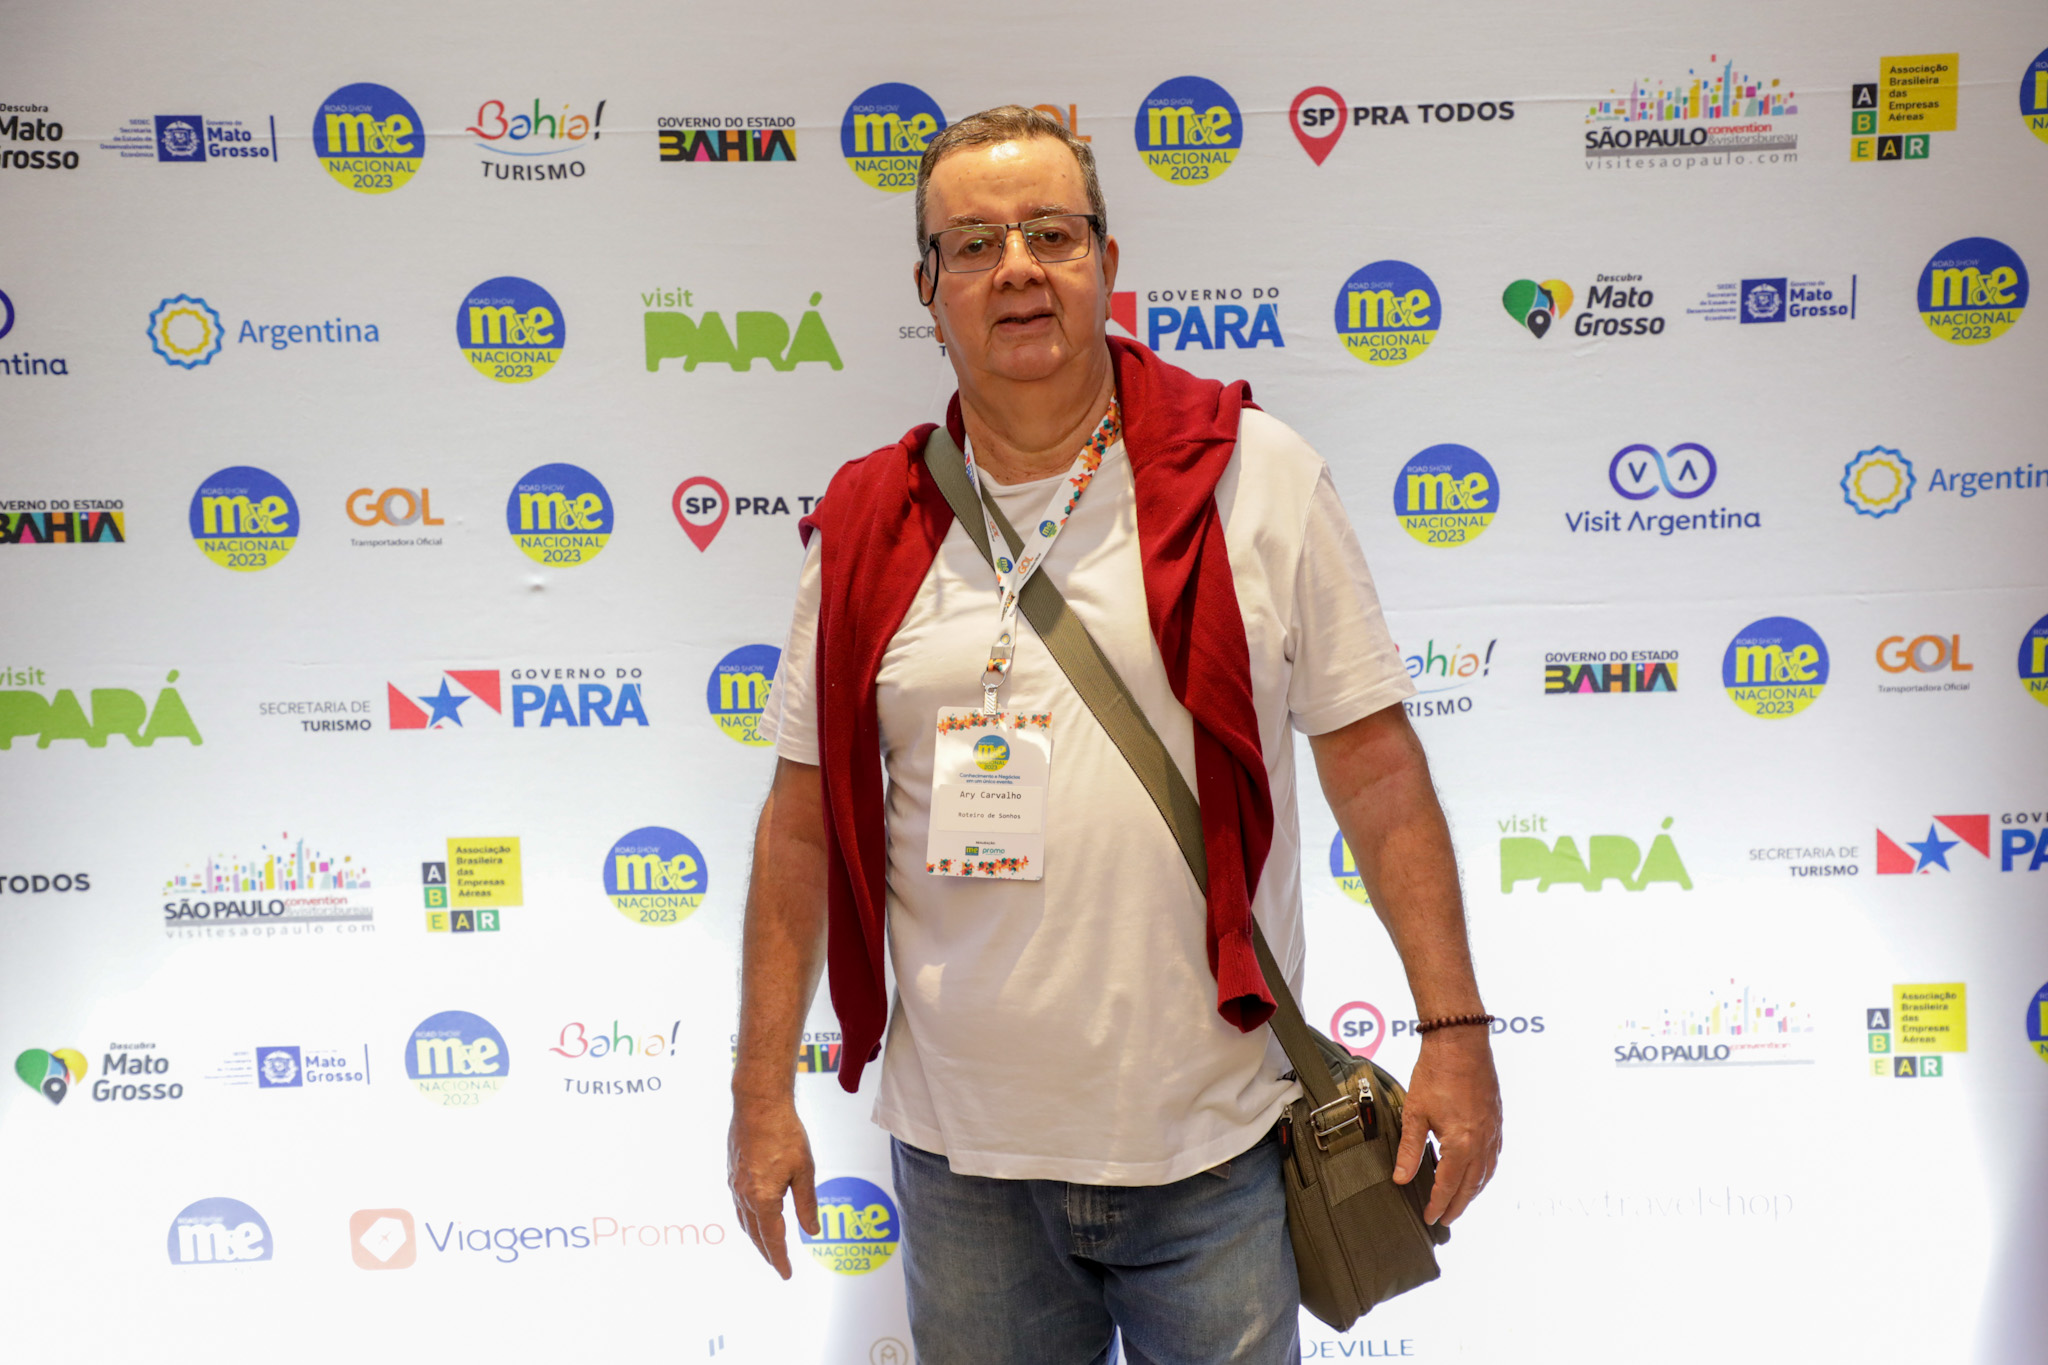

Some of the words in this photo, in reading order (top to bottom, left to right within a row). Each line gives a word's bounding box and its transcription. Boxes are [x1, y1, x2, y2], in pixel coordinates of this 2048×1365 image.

[1889, 64, 1948, 75] Associação
[1889, 78, 1939, 86] Brasileira
[1889, 90, 1907, 98] das
[0, 103, 48, 113] Descubra
[1148, 98, 1168, 106] ROAD
[1889, 103, 1939, 113] Empresas
[465, 98, 607, 141] Bahia!
[1302, 108, 1336, 126] SP
[1353, 105, 1410, 126] PRA
[1418, 101, 1515, 123] TODOS
[0, 115, 63, 142] Mato
[657, 117, 721, 128] GOVERNO
[725, 117, 743, 127] DO
[747, 117, 796, 127] ESTADO
[1708, 123, 1772, 134] convention
[207, 128, 251, 142] Mato
[1585, 126, 1632, 150] SÃO
[1635, 127, 1708, 149] PAULO
[1708, 133, 1798, 146] &visitorsbureau
[208, 143, 269, 157] Grosso
[658, 130, 797, 162] BAHIA
[1149, 152, 1231, 165] NACIONAL
[1585, 151, 1798, 169] visitesaopaulo.com
[329, 160, 416, 173] NACIONAL
[481, 161, 586, 181] TURISMO
[878, 172, 916, 187] 2023
[1171, 166, 1209, 181] 2023
[353, 174, 393, 188] 2023
[1597, 274, 1642, 283] Descubra
[641, 288, 693, 308] visit
[1148, 288, 1242, 302] GOVERNO
[1253, 287, 1279, 299] DO
[1587, 286, 1653, 309] Mato
[1790, 289, 1832, 303] Mato
[1790, 304, 1848, 317] Grosso
[1575, 313, 1664, 337] Grosso
[1930, 312, 2015, 326] NACIONAL
[238, 318, 380, 350] Argentina
[644, 291, 843, 372] PARÁ
[1952, 326, 1991, 340] 2023
[1348, 334, 1429, 347] NACIONAL
[472, 351, 555, 363] NACIONAL
[1369, 348, 1407, 361] 2023
[494, 365, 533, 378] 2023
[1928, 464, 2048, 498] Argentin
[51, 500, 69, 510] DO
[73, 500, 123, 510] ESTADO
[346, 488, 445, 526] GOL
[685, 498, 718, 514] SP
[736, 497, 790, 515] PRA
[1407, 516, 1488, 529] NACIONAL
[1565, 511, 1622, 532] Visit
[1628, 507, 1762, 536] Argentina
[351, 538, 414, 548] Transportadora
[416, 538, 443, 546] Oficial
[521, 536, 604, 548] NACIONAL
[1428, 530, 1466, 543] 2023
[204, 541, 289, 552] NACIONAL
[228, 554, 267, 567] 2023
[543, 550, 582, 563] 2023
[1545, 652, 1606, 662] GOVERNO
[1610, 652, 1628, 661] DO
[1632, 651, 1678, 661] ESTADO
[1876, 634, 1973, 674] GOL
[511, 668, 605, 680] GOVERNO
[616, 668, 643, 679] DO
[1545, 663, 1678, 694] BAHIA
[1735, 688, 1816, 701] NACIONAL
[1878, 685, 1941, 694] Transportadora
[1944, 682, 1970, 691] Oficial
[260, 702, 347, 715] SECRETARIA
[352, 701, 371, 713] DE
[1756, 701, 1794, 715] 2023
[302, 719, 372, 732] TURISMO
[960, 790, 976, 801] Ary
[980, 791, 1022, 800] Carvalho
[1498, 815, 1548, 833] visit
[456, 844, 511, 855] Associação
[1500, 817, 1693, 894] PARÁ
[1749, 848, 1835, 861] SECRETARIA
[1839, 847, 1859, 858] DE
[456, 856, 503, 864] Brasileira
[457, 867, 474, 875] das
[1789, 866, 1859, 876] TURISMO
[458, 879, 505, 888] Empresas
[458, 888, 492, 897] Aéreas
[284, 896, 347, 906] convention
[618, 897, 698, 907] NACIONAL
[164, 899, 210, 920] SÃO
[214, 899, 284, 918] PAULO
[640, 909, 677, 922] 2023
[1902, 992, 1957, 1000] Associação
[1902, 1003, 1949, 1012] Brasileira
[1902, 1014, 1919, 1022] das
[1342, 1021, 1374, 1037] SP
[1902, 1025, 1950, 1034] Empresas
[549, 1020, 681, 1058] Bahia!
[1903, 1035, 1936, 1043] Aéreas
[110, 1042, 156, 1050] Descubra
[1614, 1043, 1657, 1062] SÃO
[1661, 1045, 1730, 1061] PAULO
[103, 1053, 169, 1075] Mato
[305, 1056, 346, 1068] Mato
[306, 1070, 363, 1083] Grosso
[92, 1080, 183, 1102] Grosso
[564, 1076, 662, 1095] TURISMO
[425, 1215, 725, 1263] ViagensPromo
[813, 1245, 891, 1256] NACIONAL
[834, 1258, 871, 1271] 2023
